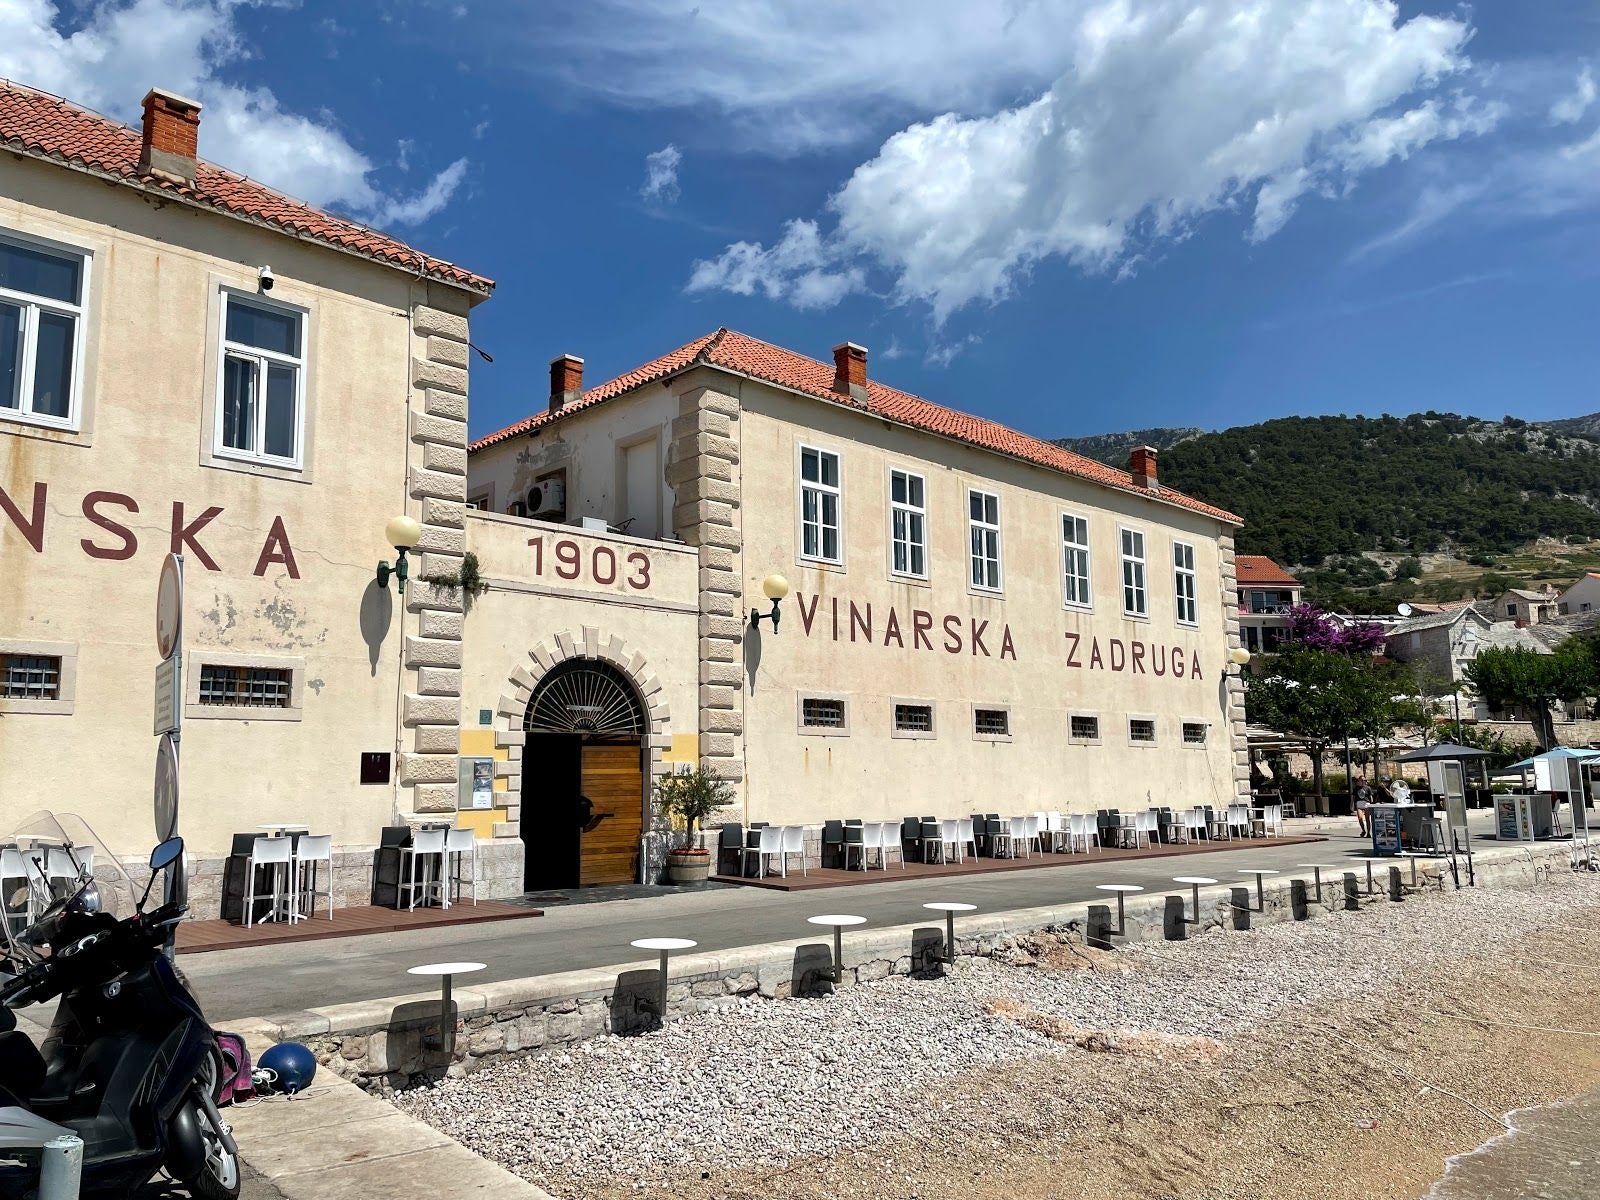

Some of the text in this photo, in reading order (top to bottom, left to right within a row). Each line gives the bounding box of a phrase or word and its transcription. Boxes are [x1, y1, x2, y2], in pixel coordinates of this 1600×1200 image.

[527, 536, 651, 590] 1903
[795, 592, 1203, 680] VINARSKA ZADRUGA
